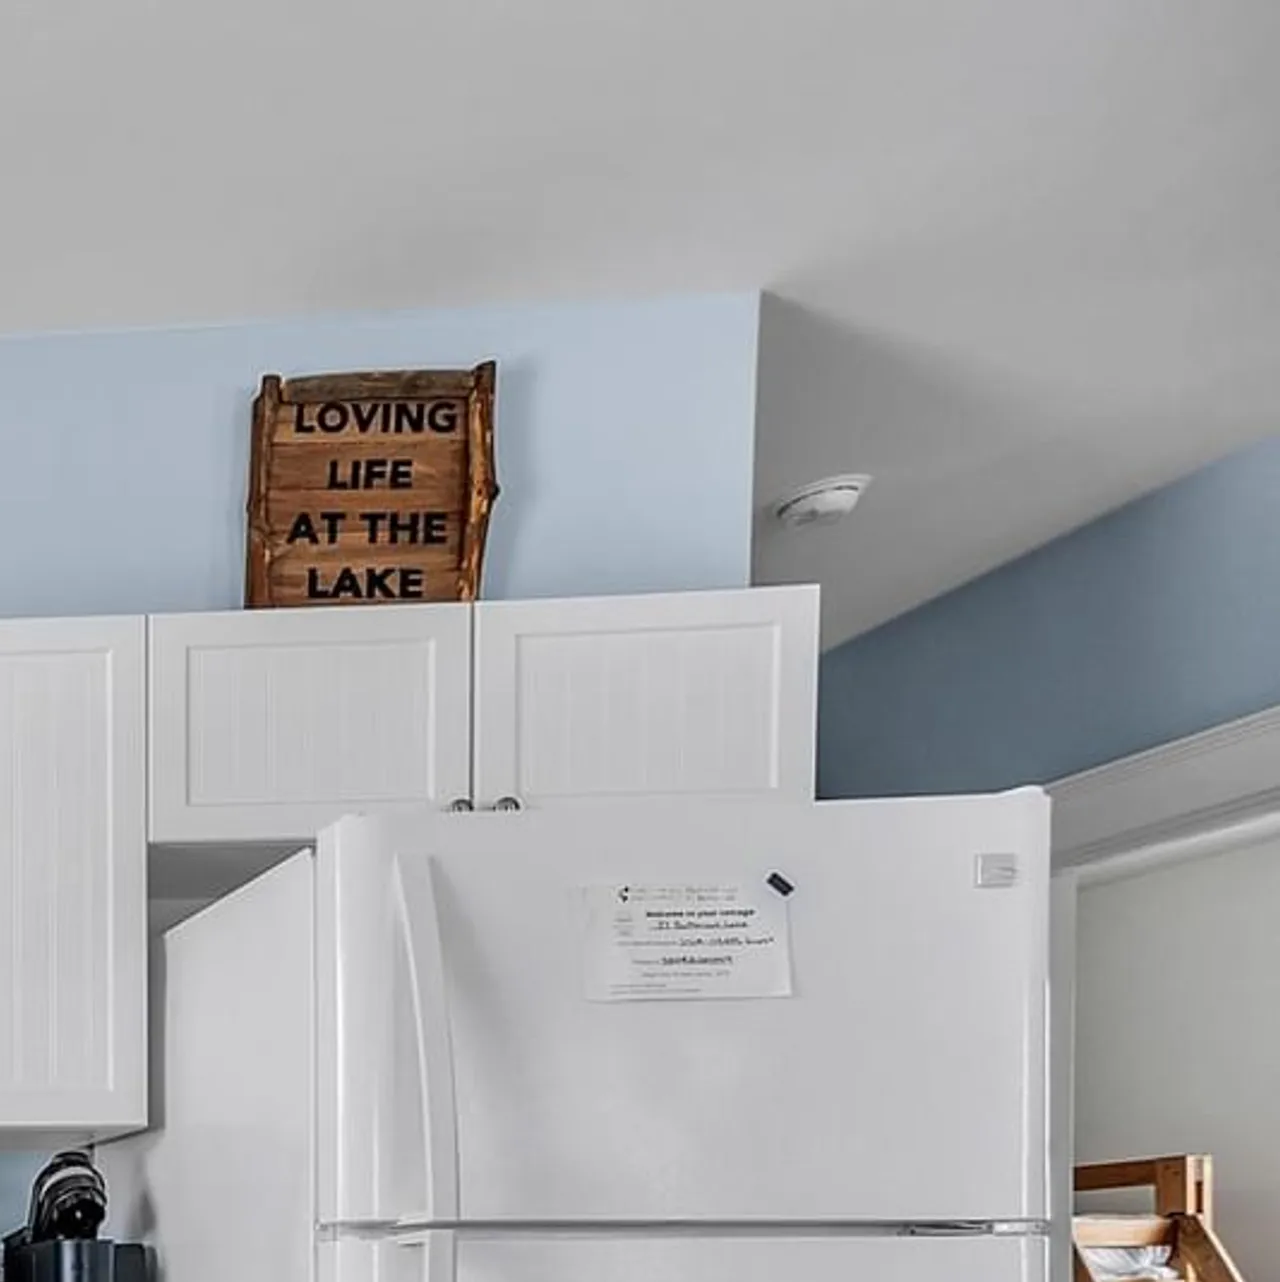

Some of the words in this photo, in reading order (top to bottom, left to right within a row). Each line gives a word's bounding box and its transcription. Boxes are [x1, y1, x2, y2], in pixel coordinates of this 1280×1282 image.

[294, 402, 458, 434] LOVING
[327, 459, 413, 490] LIFE
[287, 512, 346, 545] AT
[360, 512, 448, 545] THE
[306, 567, 424, 599] LAKE
